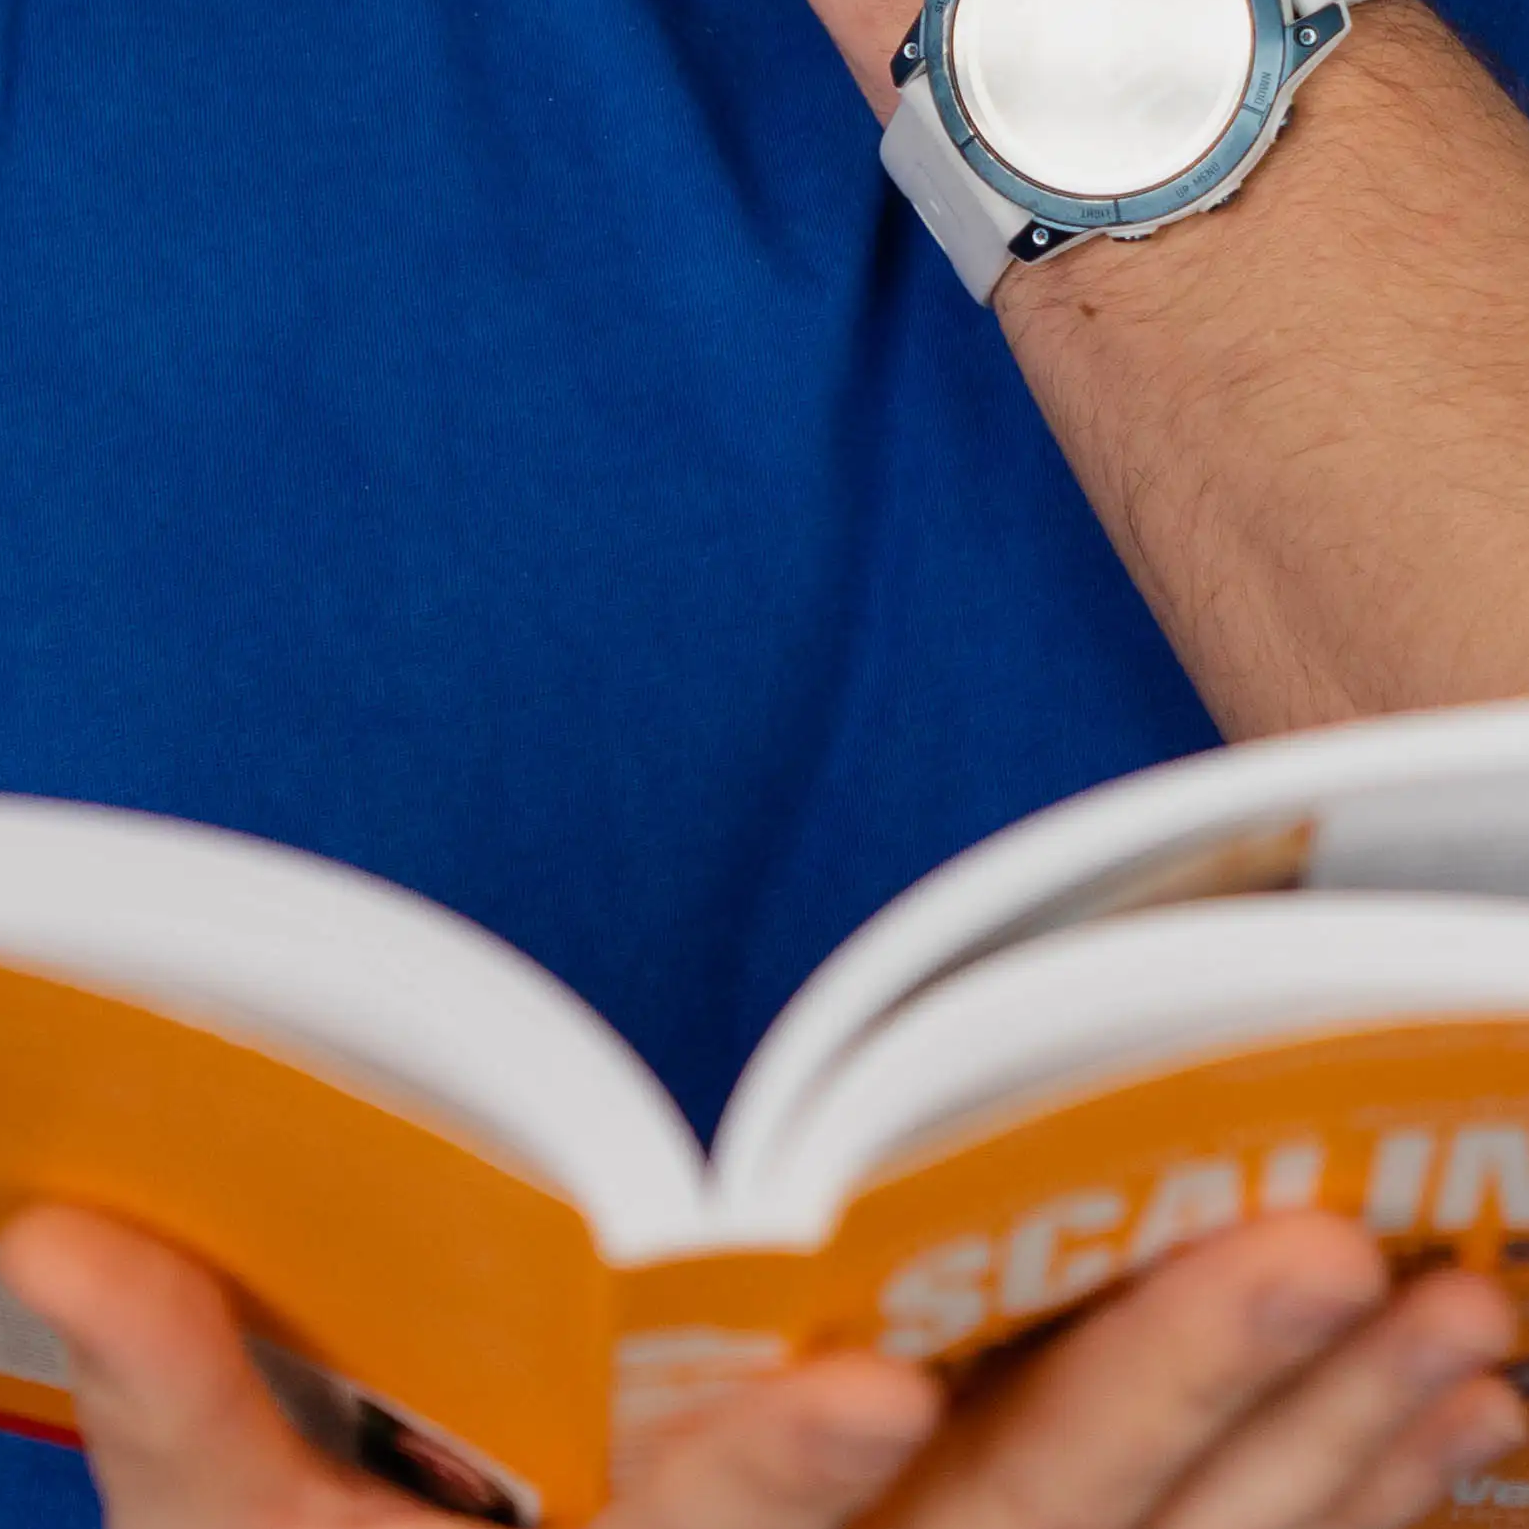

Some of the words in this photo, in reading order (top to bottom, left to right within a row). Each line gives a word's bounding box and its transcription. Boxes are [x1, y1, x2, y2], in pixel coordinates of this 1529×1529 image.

[1254, 71, 1271, 105] DOWN
[1175, 184, 1189, 199] UP
[1192, 161, 1221, 185] MENU
